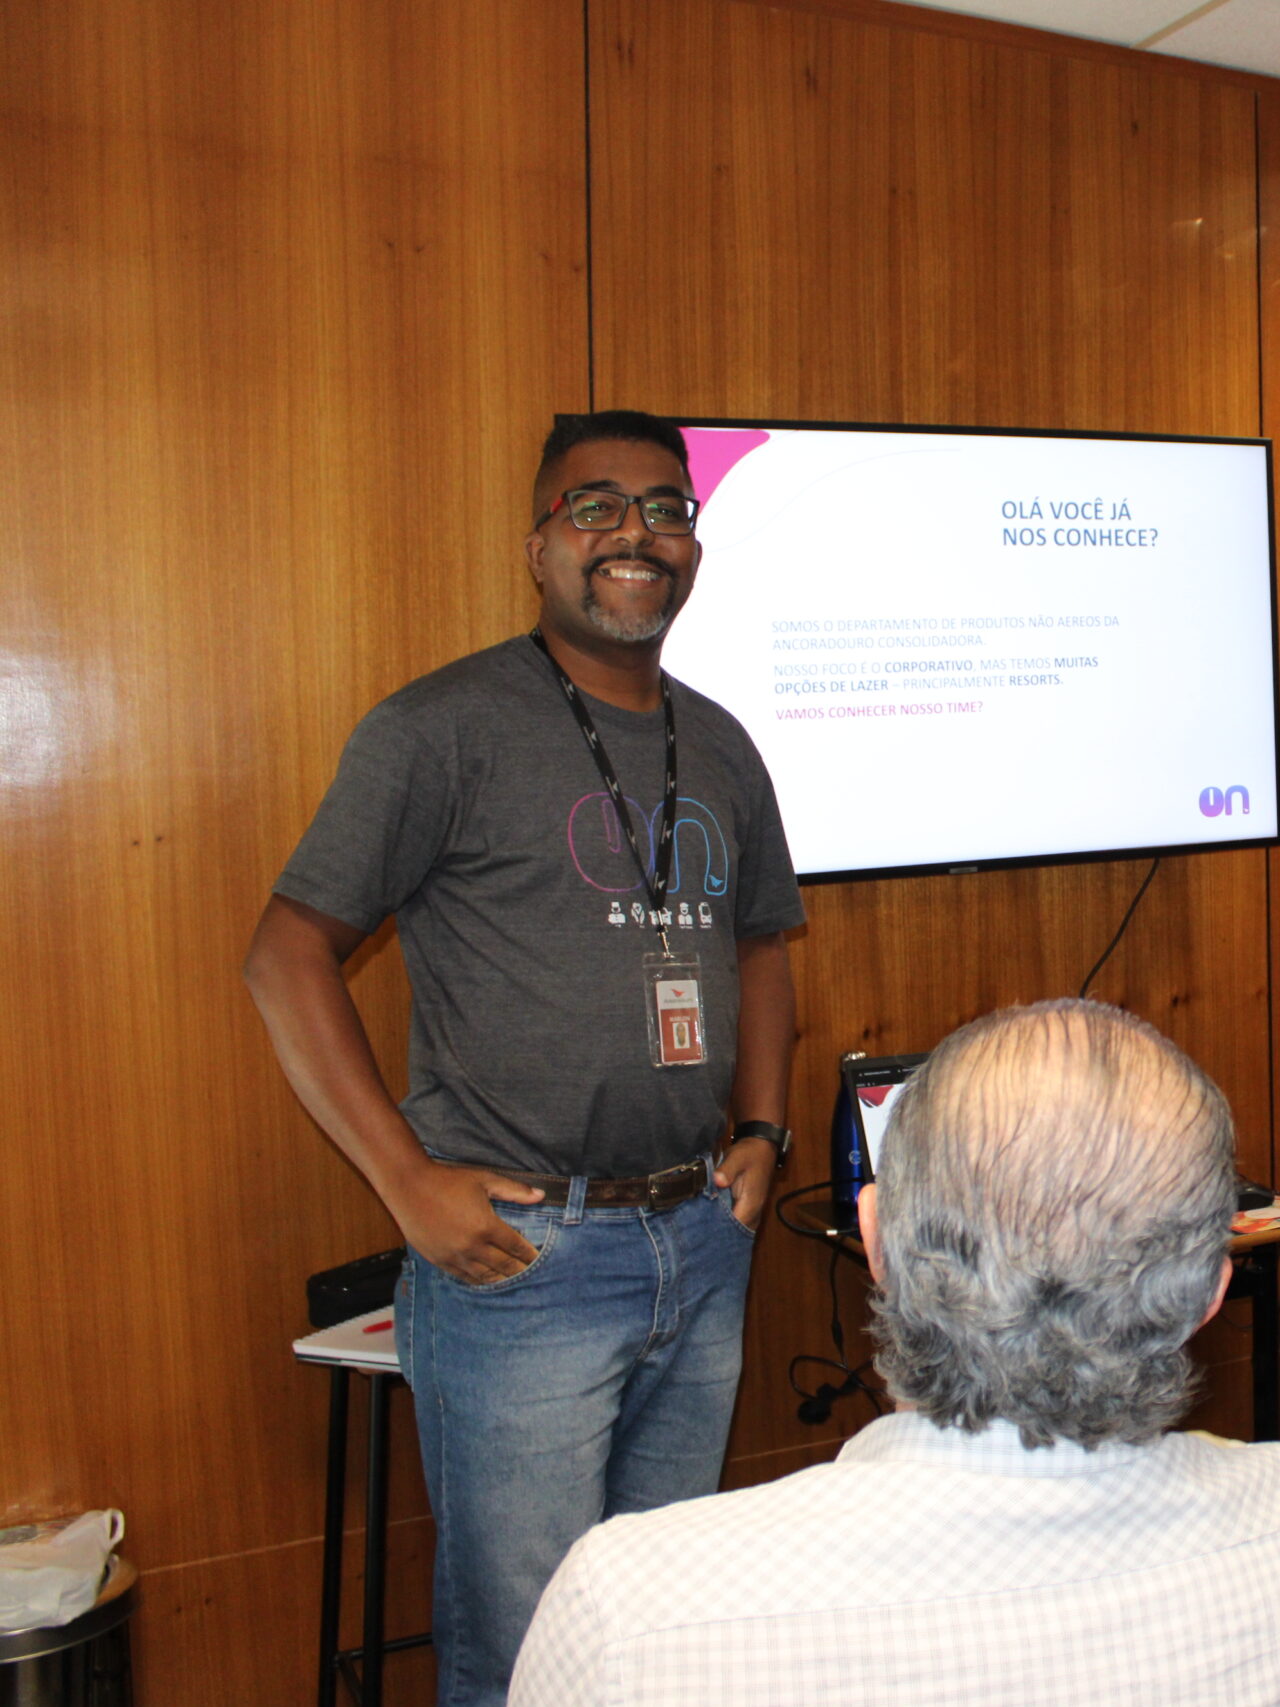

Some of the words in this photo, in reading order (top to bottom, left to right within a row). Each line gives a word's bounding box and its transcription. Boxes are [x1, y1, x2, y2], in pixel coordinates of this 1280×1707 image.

[1001, 496, 1044, 520] OLÁ
[1049, 496, 1104, 520] VOCÊ
[1110, 497, 1132, 521] JÁ
[1003, 527, 1047, 547] NOS
[1053, 527, 1158, 547] CONHECE?
[771, 620, 820, 633] SOMOS
[823, 619, 834, 632] O
[837, 618, 938, 632] DEPARTAMENTO
[941, 617, 956, 630] DE
[960, 616, 1025, 630] PRODUTOS
[1028, 613, 1054, 628] NÃO
[1057, 615, 1101, 628] AEREOS
[1103, 615, 1120, 627] DA
[772, 636, 875, 651] ANCORADOURO
[877, 634, 987, 649] CONSOLIDADORA.
[773, 664, 819, 677] NOSSO
[822, 662, 858, 675] FOCO
[871, 661, 882, 674] O
[884, 659, 977, 674] CORPORATIVO,
[980, 658, 1007, 671] MAS
[1009, 657, 1051, 670] TEMOS
[1054, 656, 1100, 669] MUITAS
[774, 679, 827, 696] OPÇÕES
[830, 680, 847, 693] DE
[850, 679, 889, 692] LAZER
[903, 675, 1006, 690] PRINCIPALMENTE
[1008, 674, 1064, 687] RESORTS.
[775, 706, 826, 720] VAMOS
[828, 704, 898, 719] CONHECER
[900, 702, 944, 717] NOSSO
[947, 700, 984, 714] TIME?
